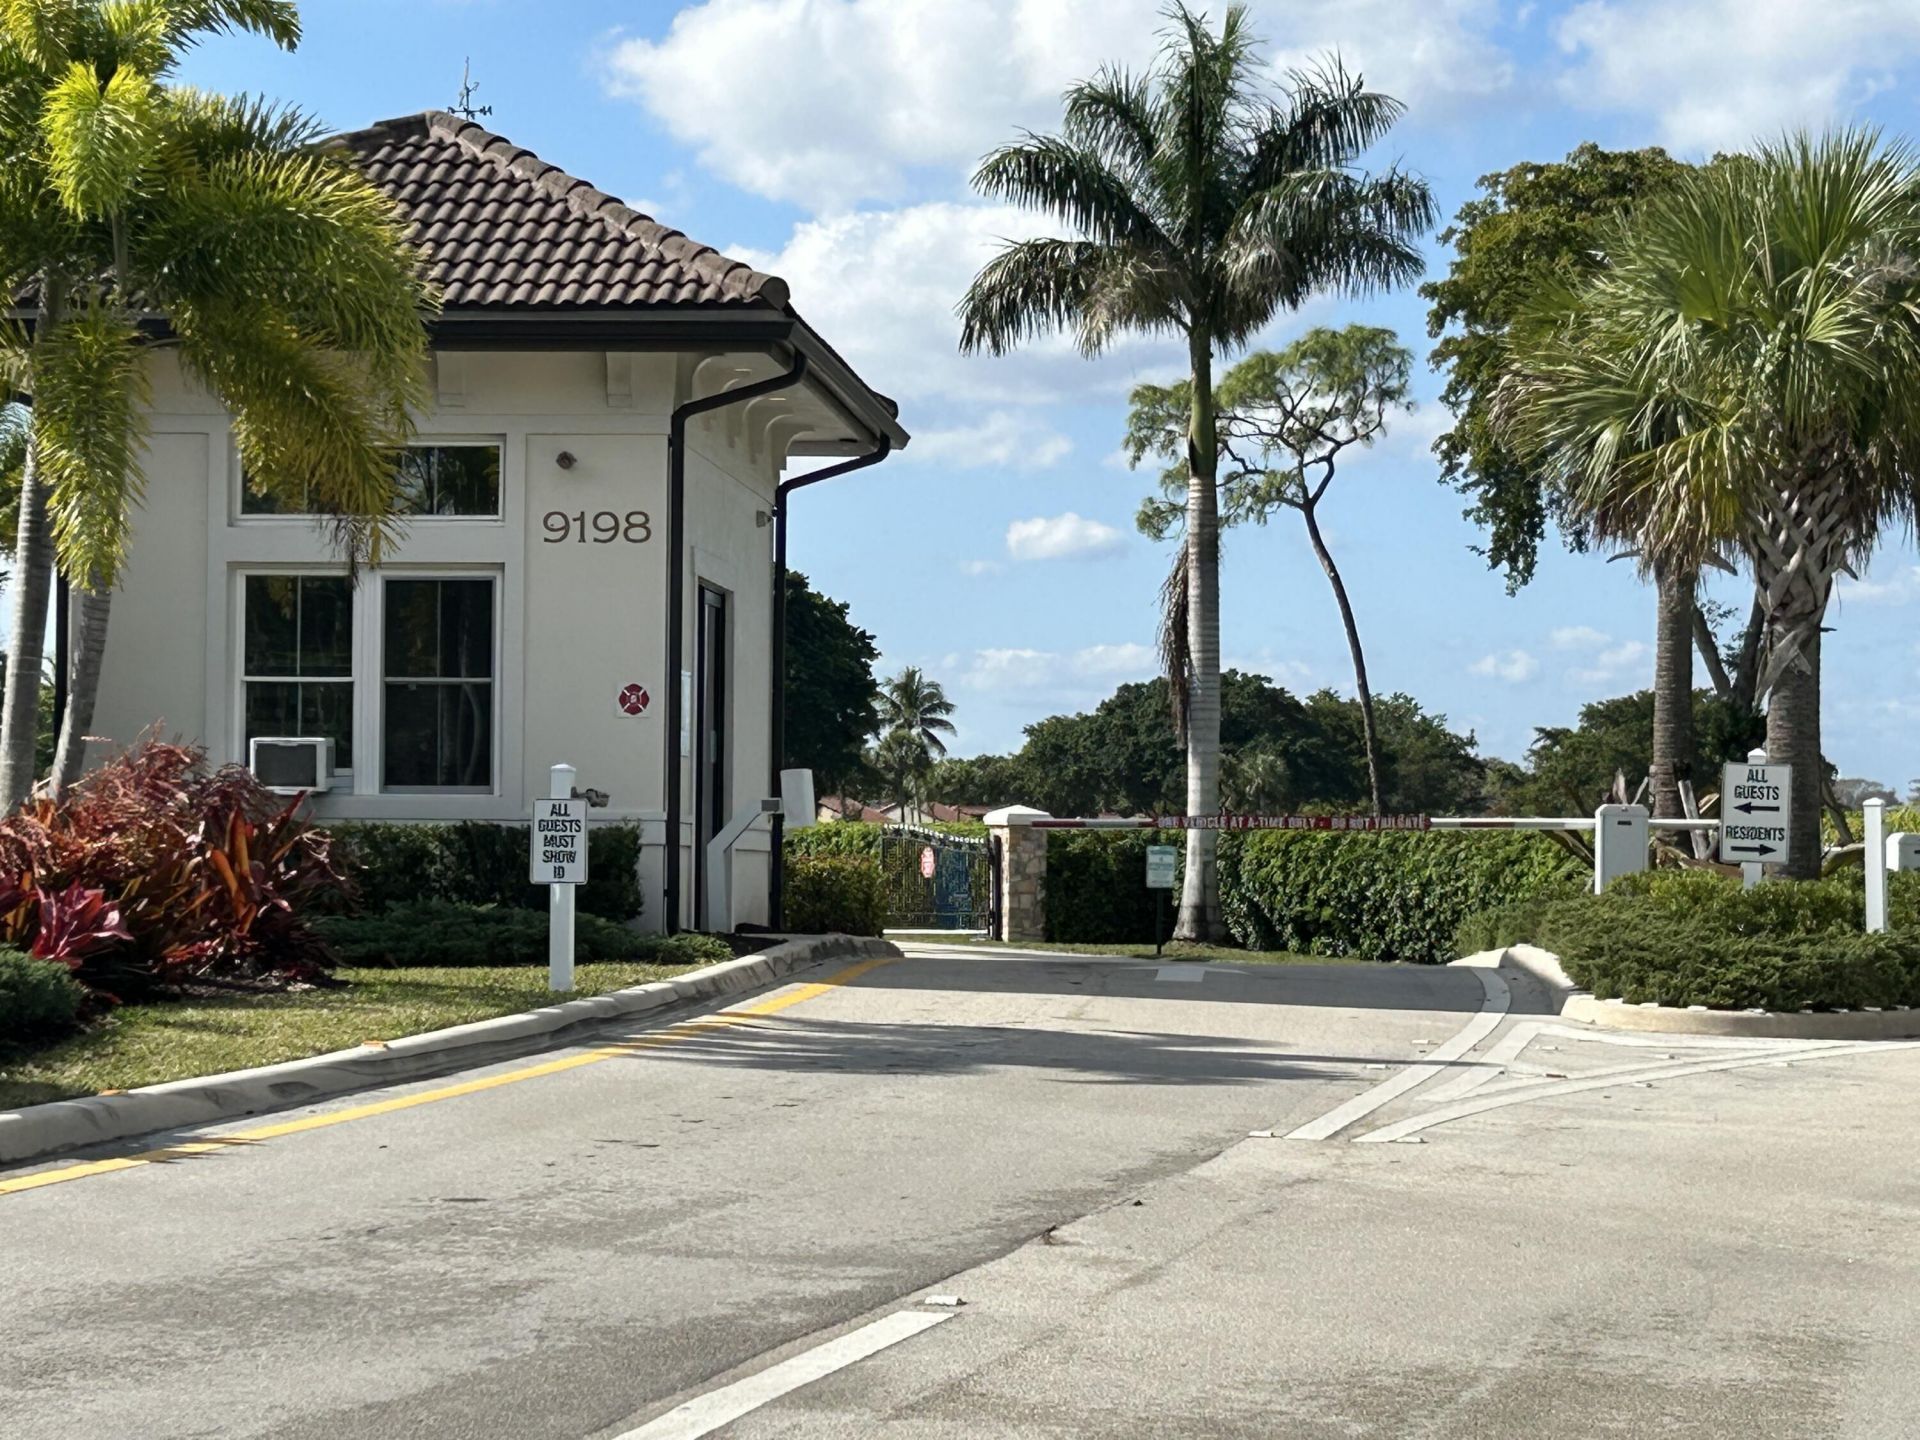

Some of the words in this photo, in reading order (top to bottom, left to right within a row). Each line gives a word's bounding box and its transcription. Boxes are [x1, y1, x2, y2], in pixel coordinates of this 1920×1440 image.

[543, 510, 652, 543] 9198
[1747, 769, 1768, 783] ALL
[1734, 785, 1780, 800] GUESTS
[550, 803, 570, 816] ALL
[538, 819, 581, 832] GUESTS
[1726, 826, 1785, 841] RESIDENTS
[544, 835, 576, 848] MUST
[542, 850, 576, 863] SHOW
[553, 866, 565, 879] ID
